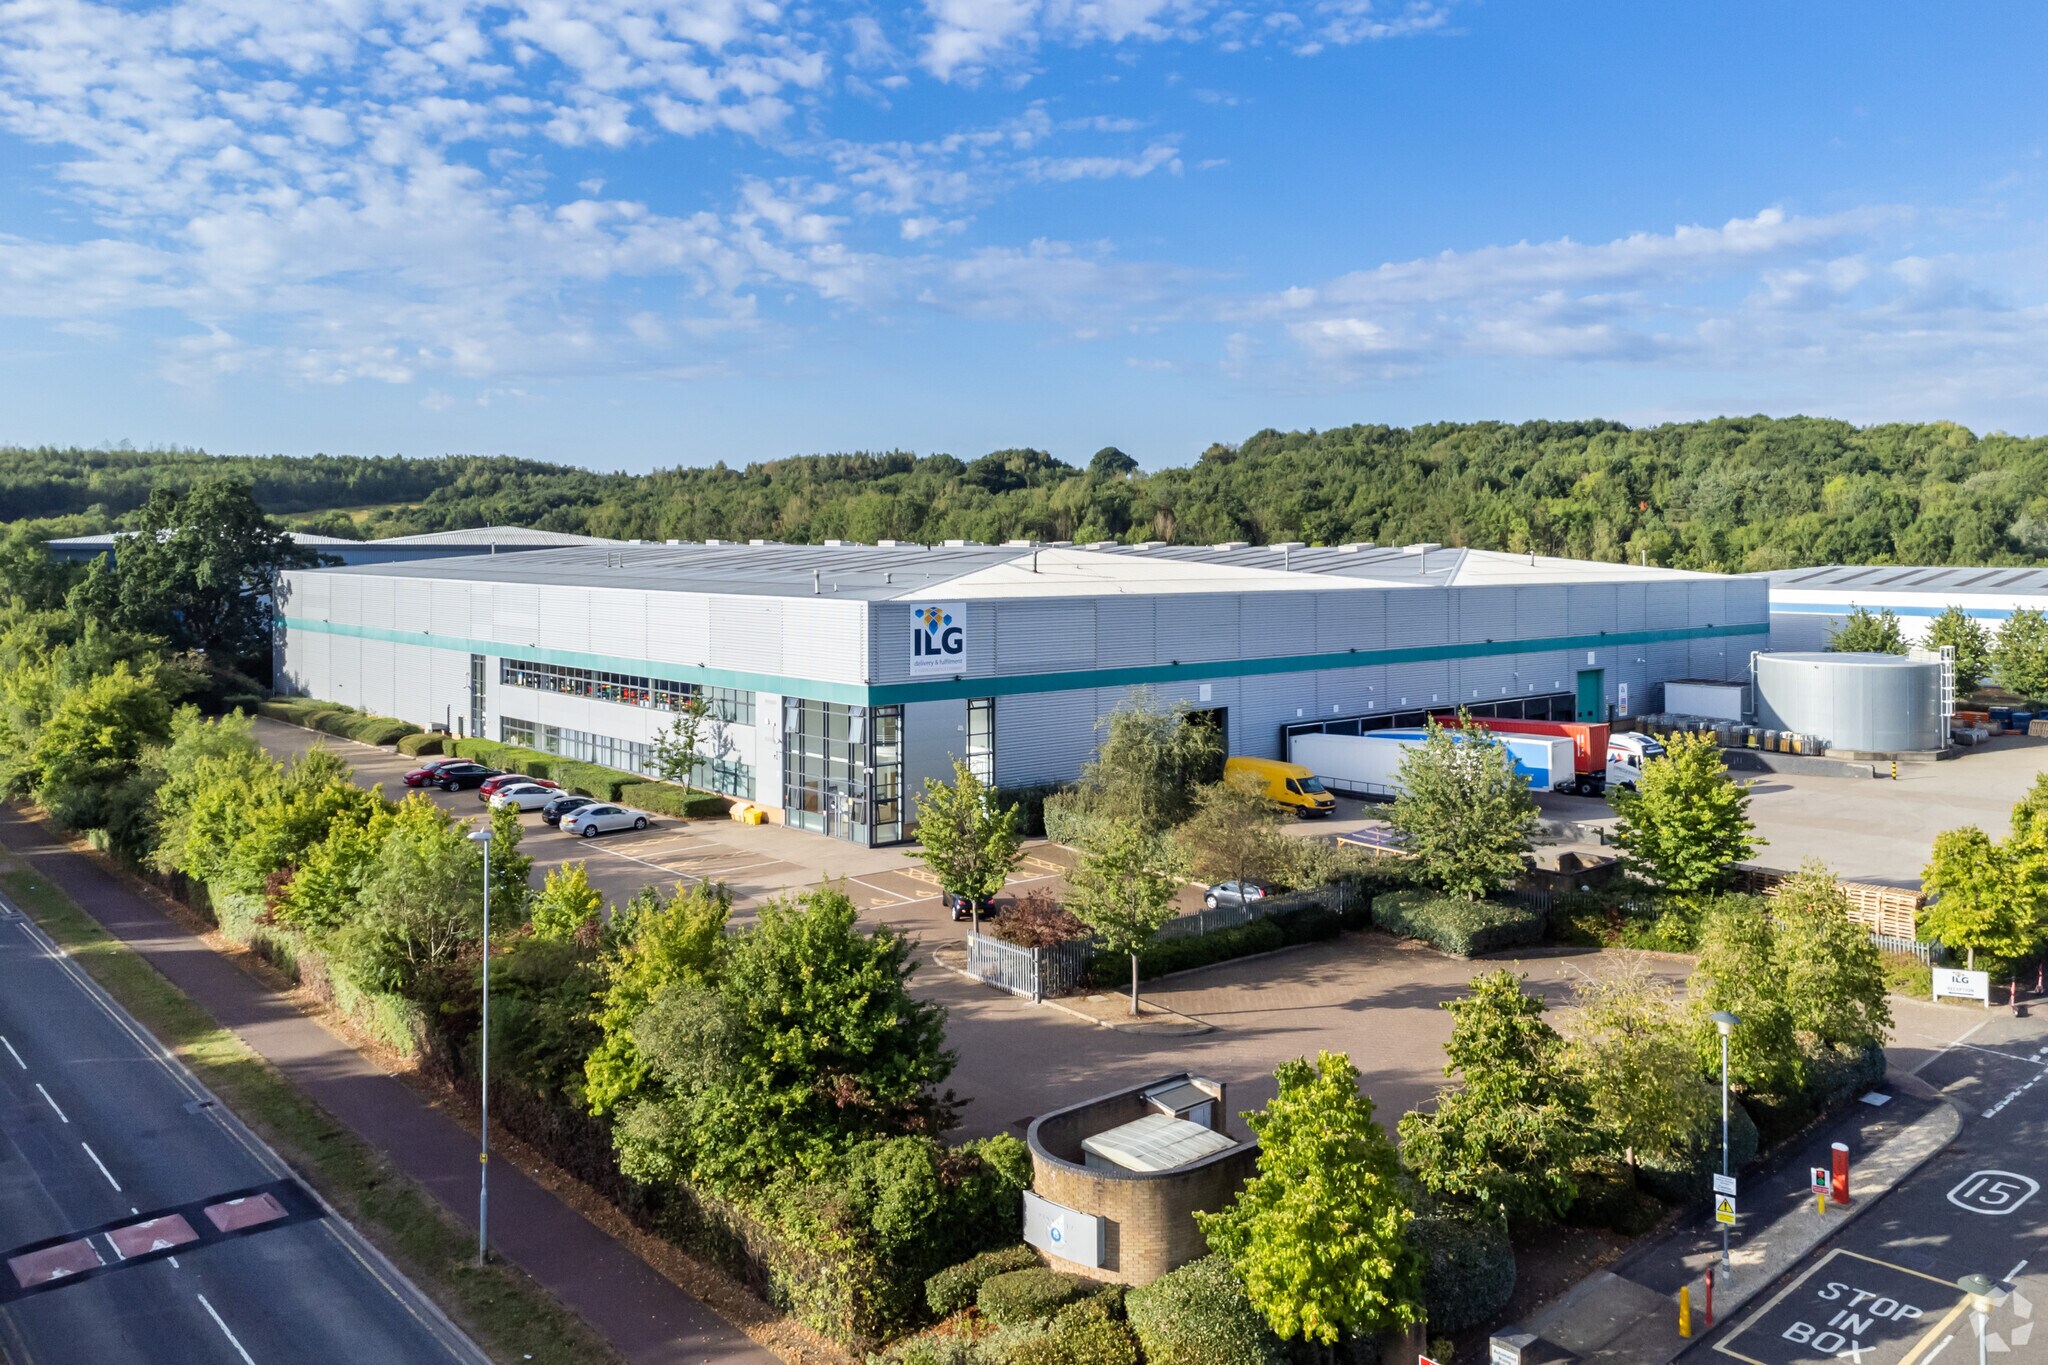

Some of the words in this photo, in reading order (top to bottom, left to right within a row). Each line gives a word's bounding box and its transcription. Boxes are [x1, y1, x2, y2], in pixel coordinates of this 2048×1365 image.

[914, 627, 963, 656] ILG
[1963, 1178, 2020, 1204] 15
[1817, 1282, 1924, 1322] STOP
[1827, 1309, 1875, 1336] IN
[1781, 1321, 1877, 1365] BOX
